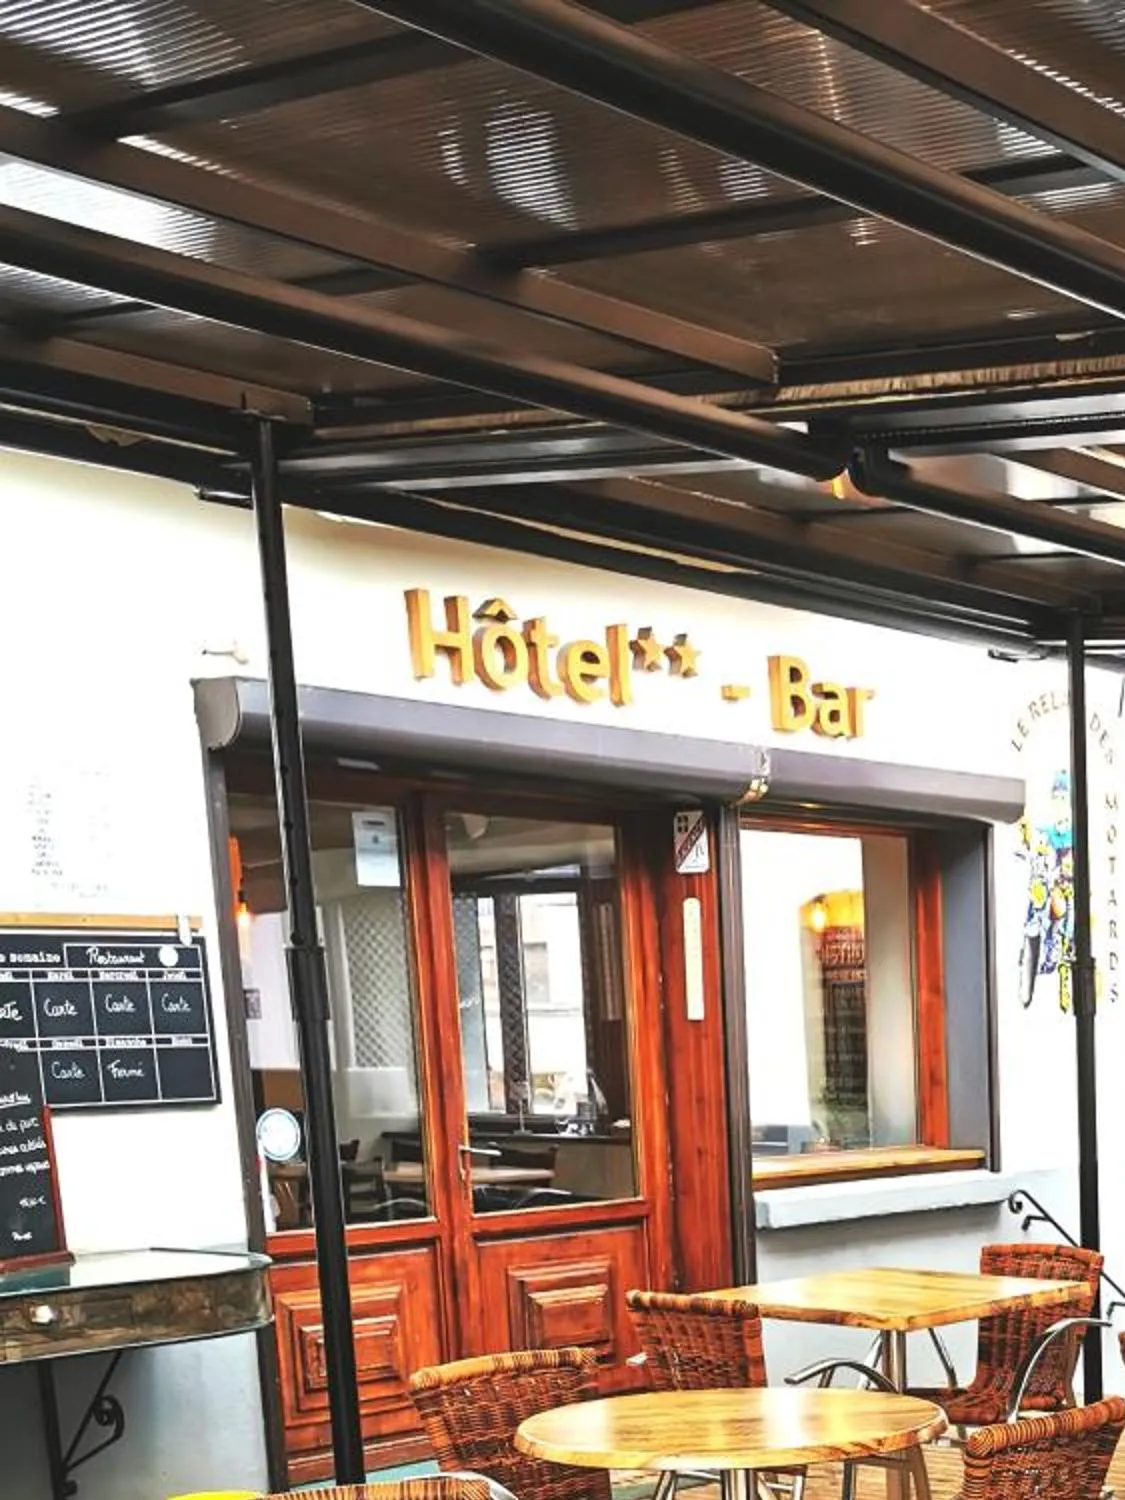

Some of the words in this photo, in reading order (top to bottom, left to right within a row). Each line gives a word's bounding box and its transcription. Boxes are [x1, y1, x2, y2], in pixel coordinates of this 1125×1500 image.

[767, 654, 876, 739] Bar
[1104, 792, 1119, 1004] MOTARDS
[43, 997, 79, 1017] Carte
[104, 993, 137, 1013] Carte
[161, 992, 193, 1013] Carte
[51, 1061, 86, 1080] Carte
